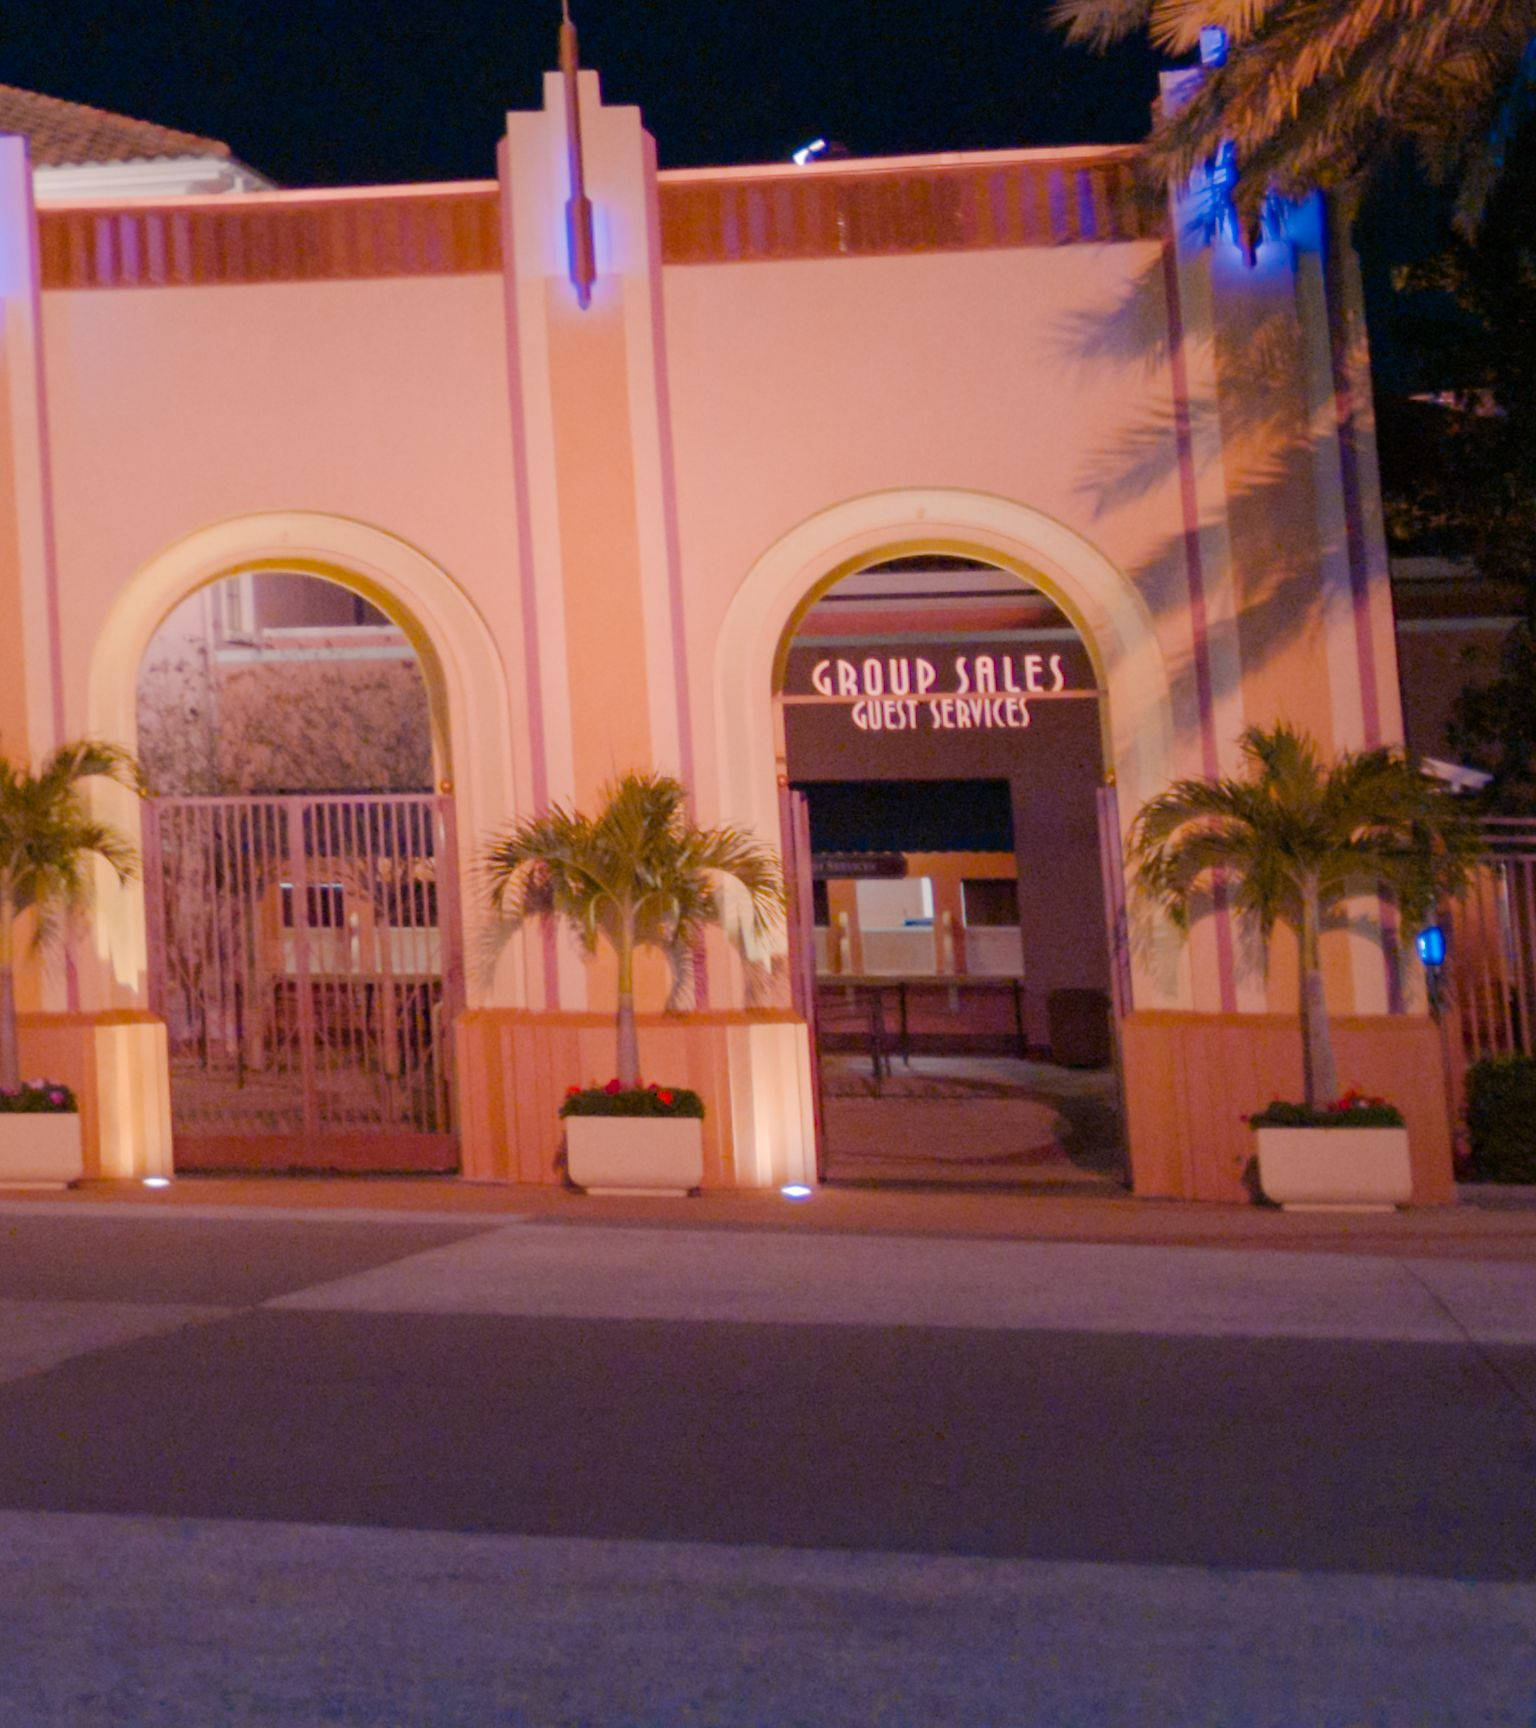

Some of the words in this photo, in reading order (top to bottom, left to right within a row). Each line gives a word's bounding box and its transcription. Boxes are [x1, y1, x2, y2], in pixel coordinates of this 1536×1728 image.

[812, 658, 937, 696] GROUP
[955, 654, 1065, 694] SALES
[852, 699, 922, 730] GUEST
[929, 697, 1031, 729] SERVICES
